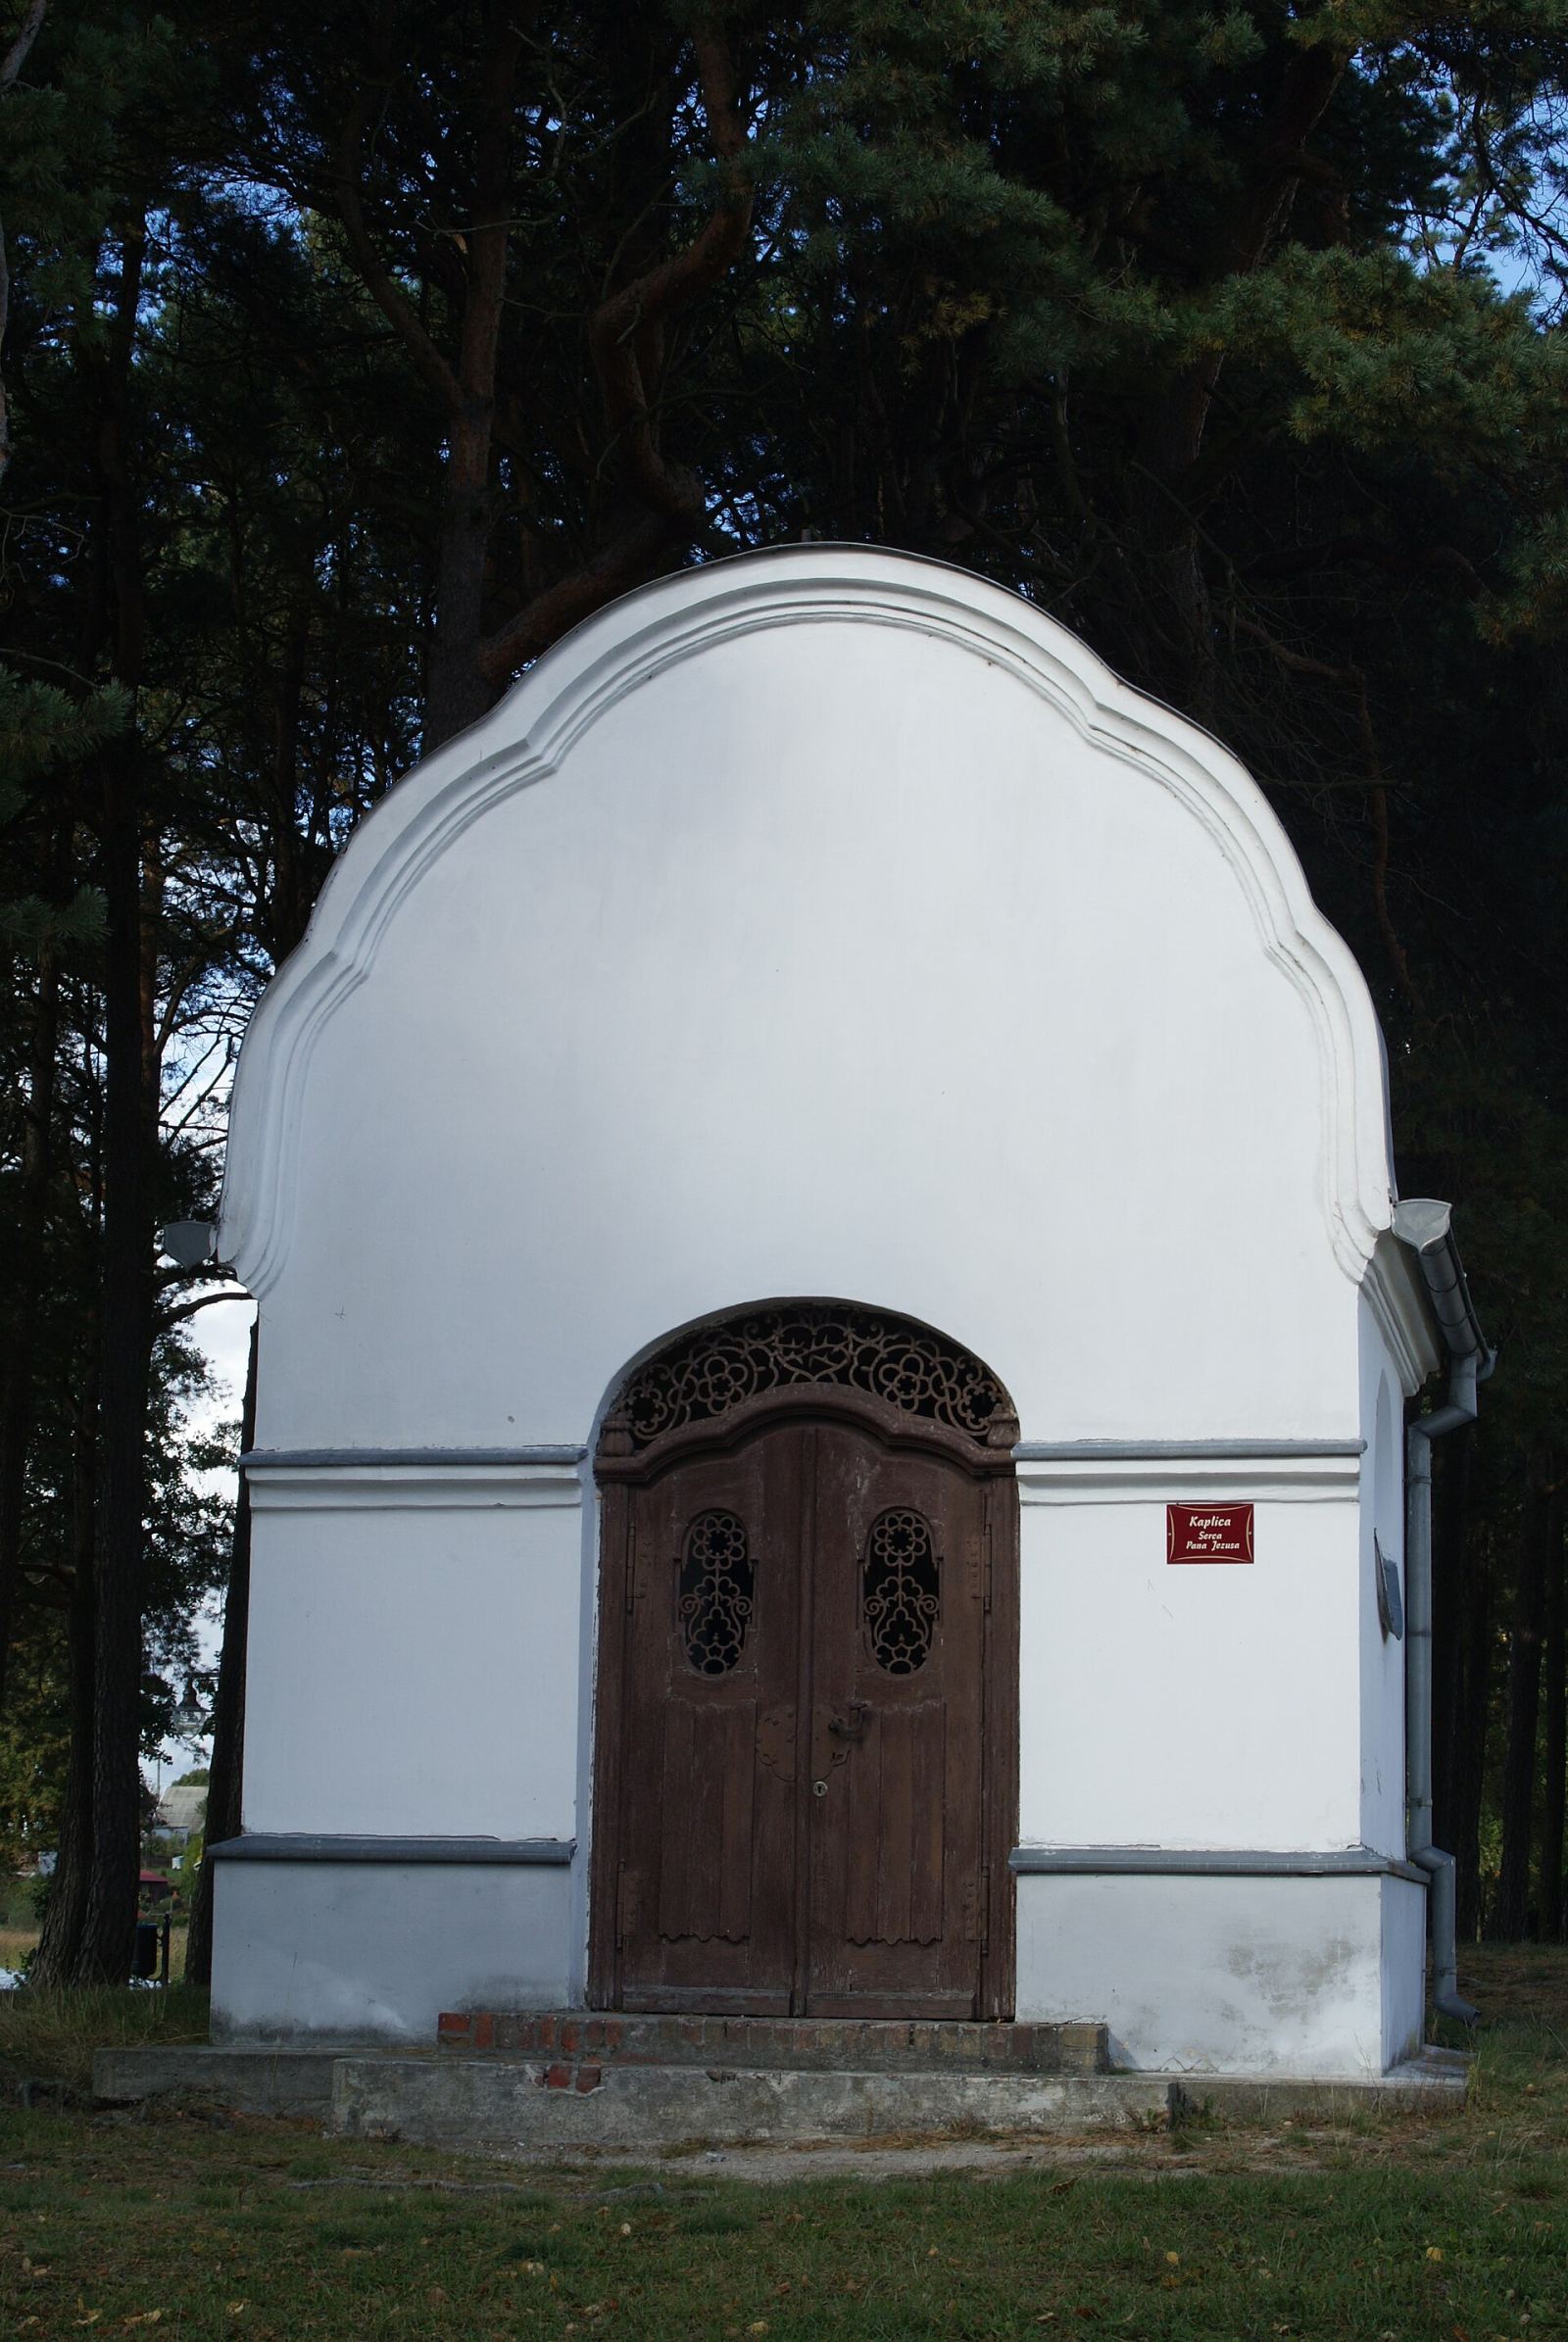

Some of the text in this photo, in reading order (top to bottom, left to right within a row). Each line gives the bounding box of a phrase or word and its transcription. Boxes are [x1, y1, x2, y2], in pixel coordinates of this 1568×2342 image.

[1189, 1516, 1232, 1529] Kaplica
[1198, 1531, 1222, 1539] Serca
[1186, 1539, 1240, 1551] Pana Jezusa
